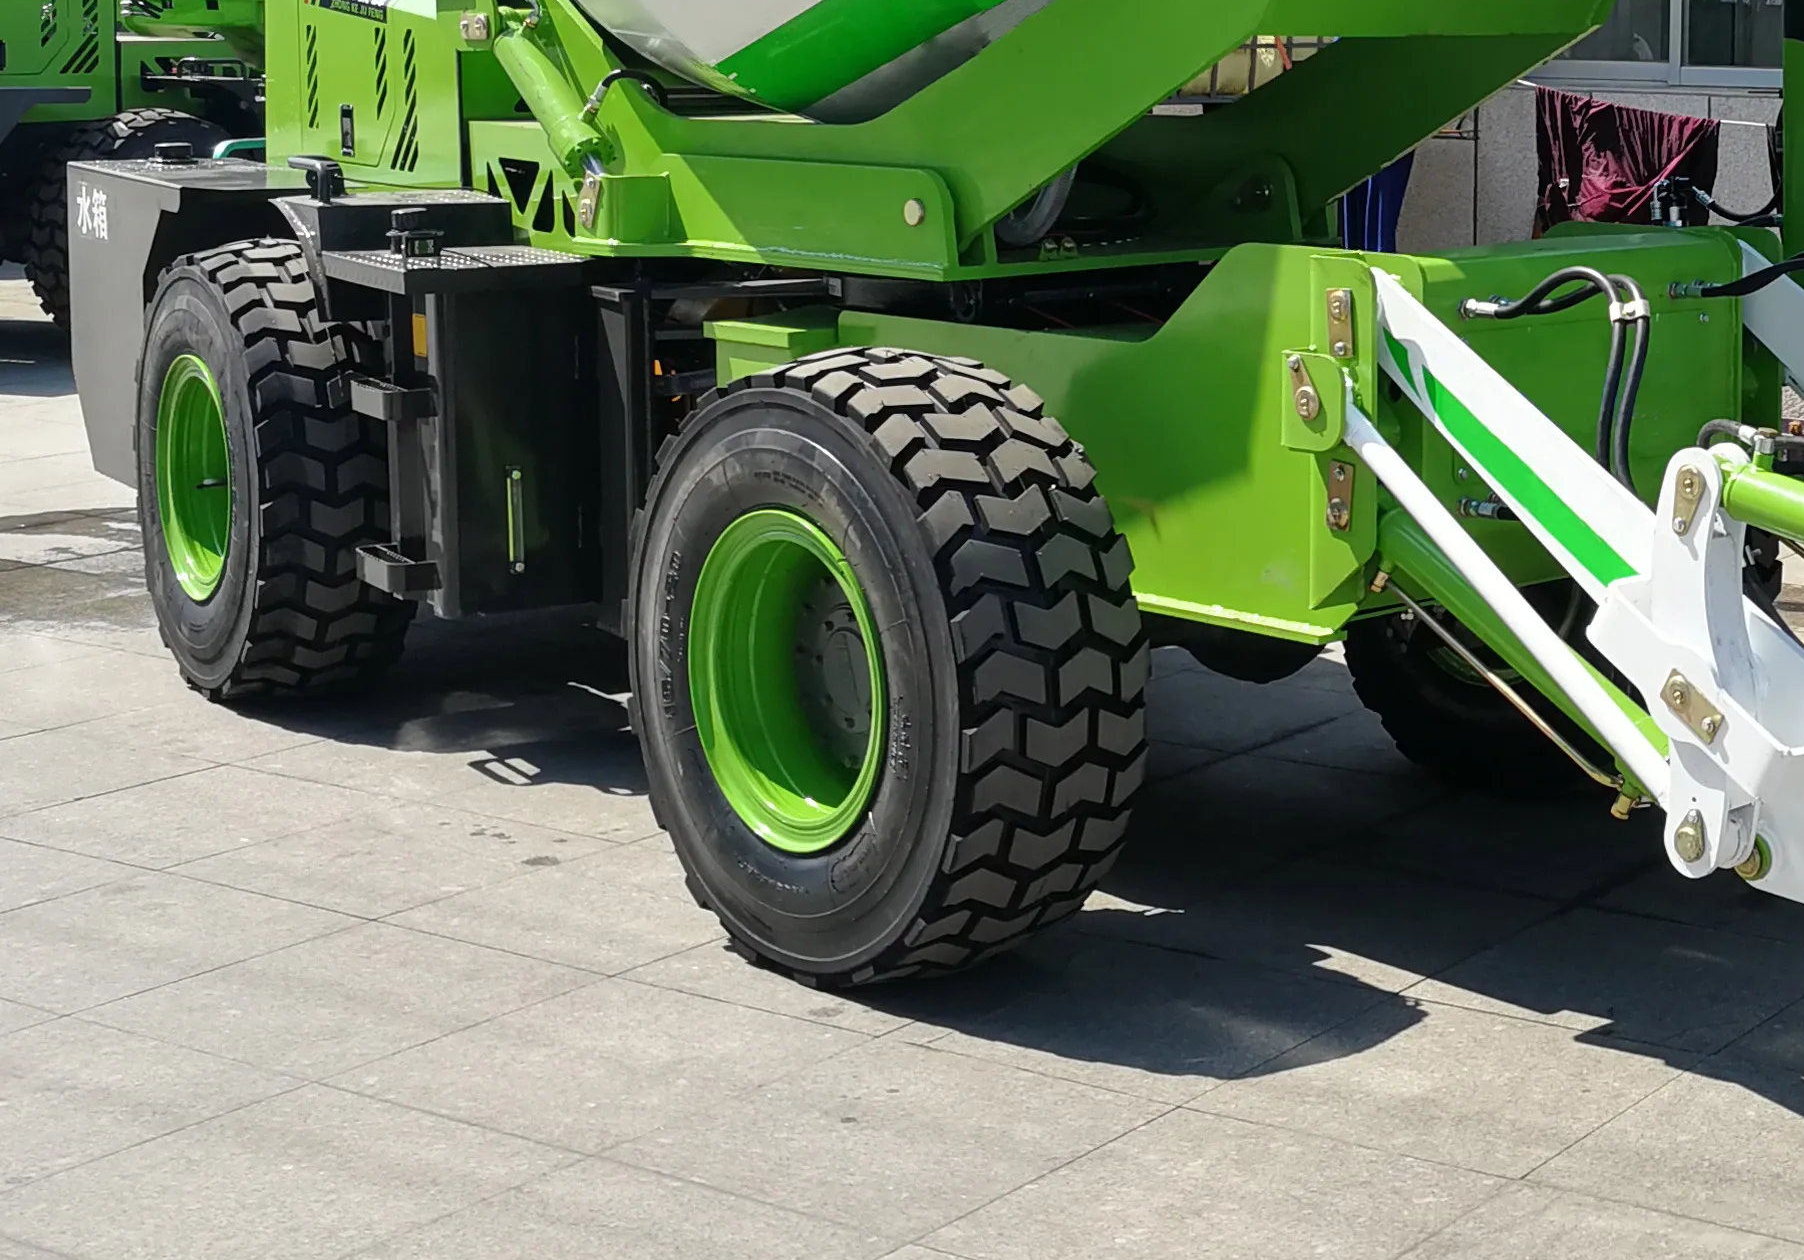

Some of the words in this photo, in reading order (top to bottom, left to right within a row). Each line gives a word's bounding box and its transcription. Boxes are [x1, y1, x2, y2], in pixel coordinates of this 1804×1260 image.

[351, 1, 360, 14] KE
[368, 6, 384, 20] FENG
[76, 186, 108, 240] 水箱
